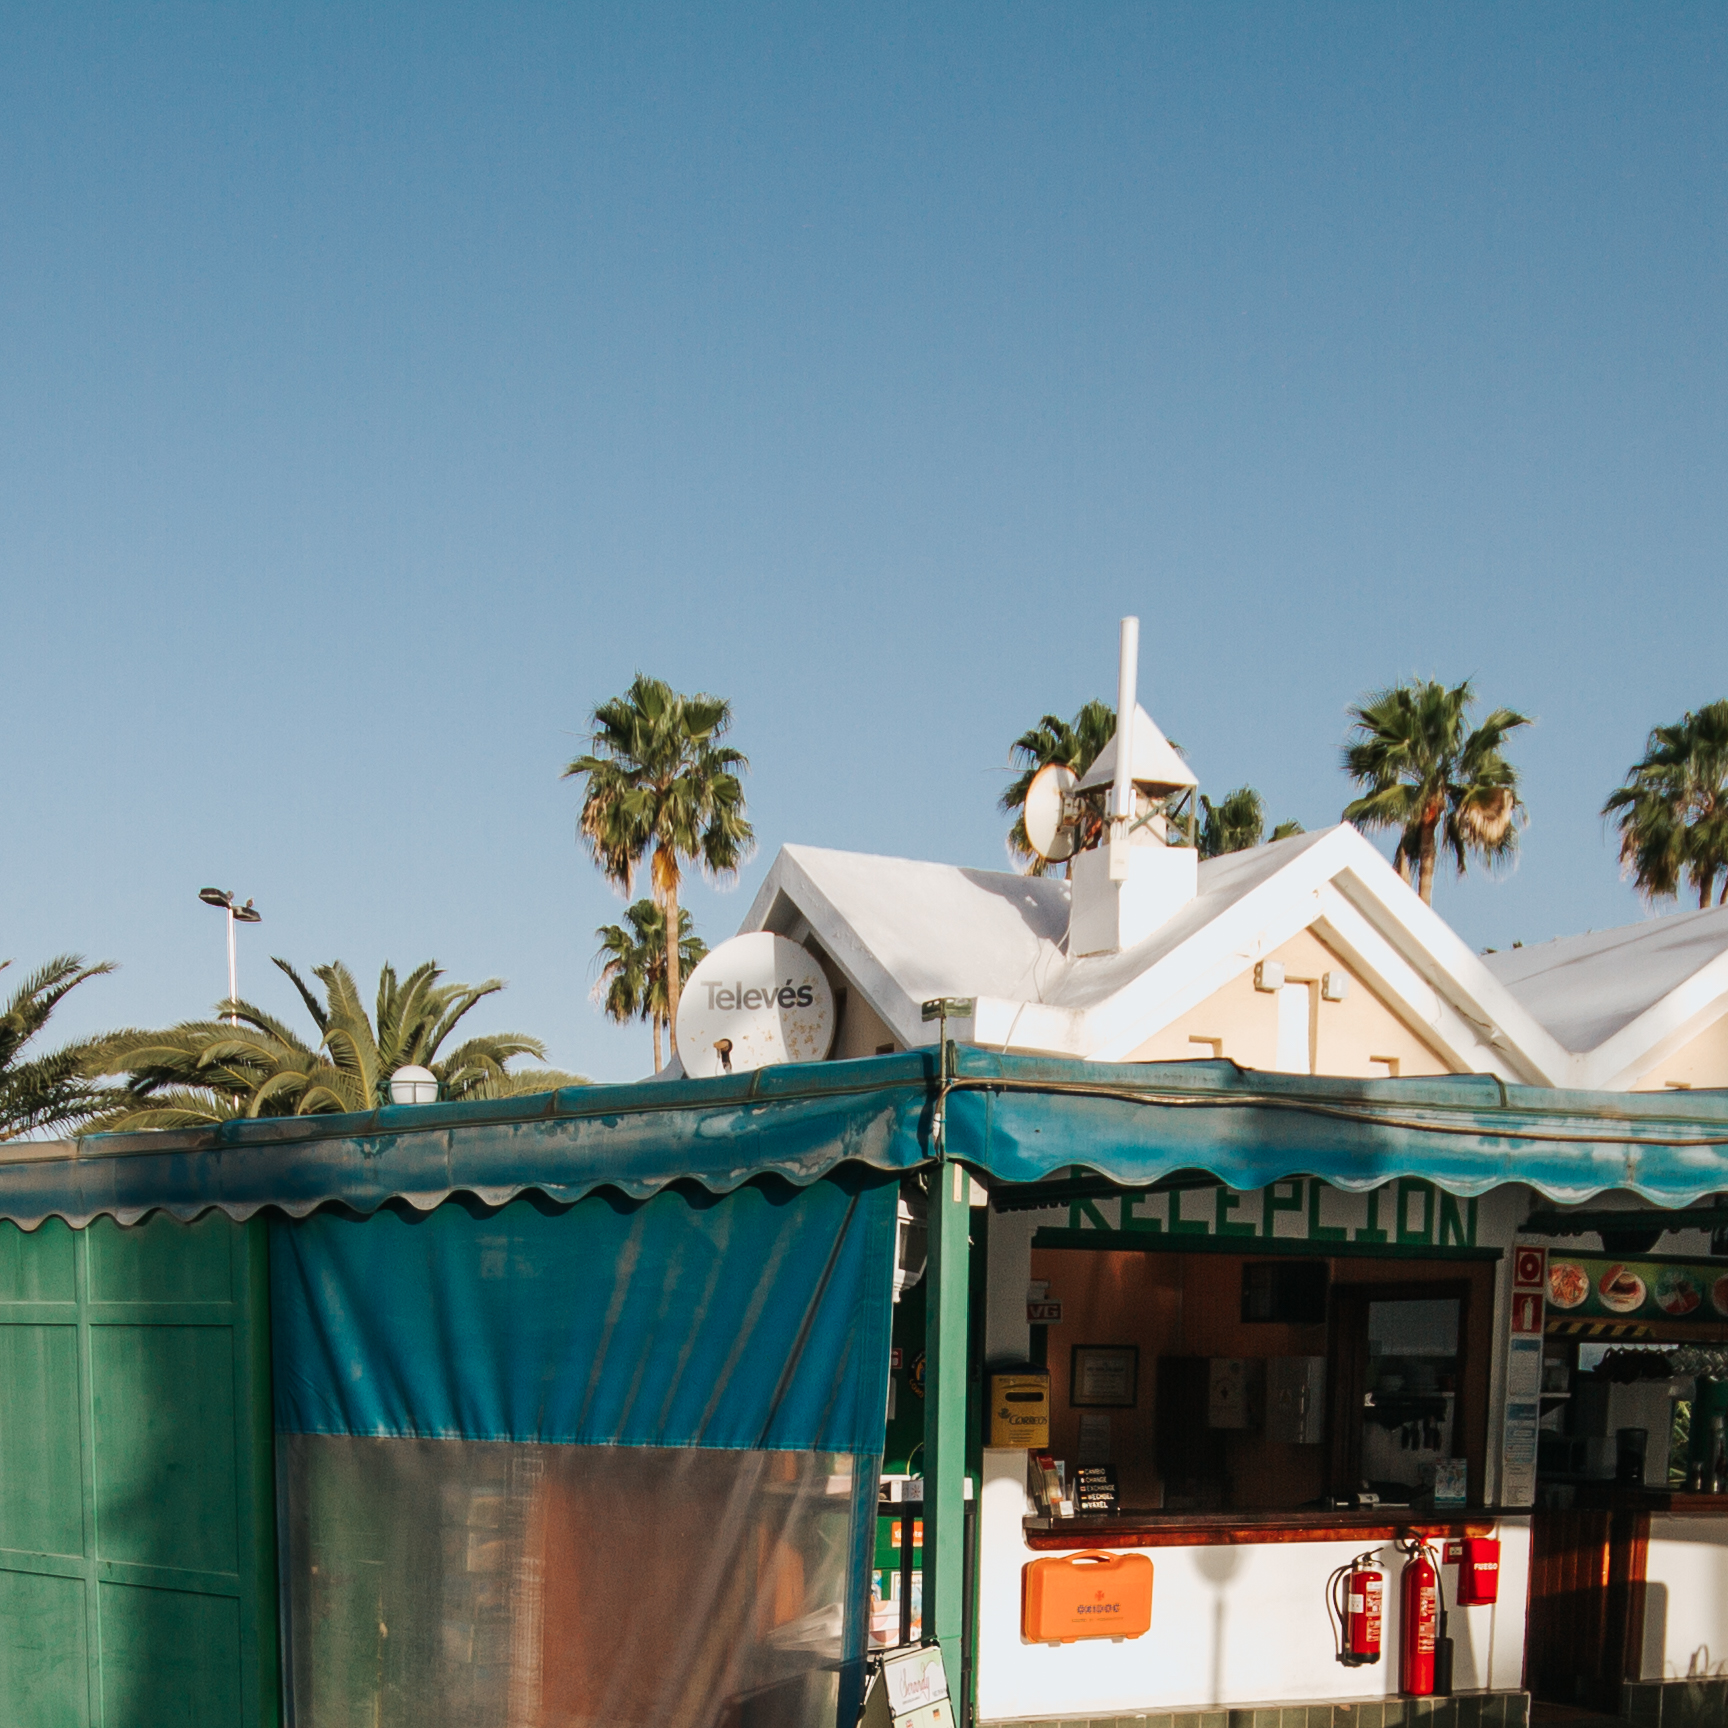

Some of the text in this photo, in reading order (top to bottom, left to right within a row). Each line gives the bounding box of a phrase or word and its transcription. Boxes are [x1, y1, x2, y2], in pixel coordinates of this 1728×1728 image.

[700, 979, 814, 1010] Televés
[1029, 1305, 1059, 1318] VG
[1473, 1562, 1498, 1571] FUEGO
